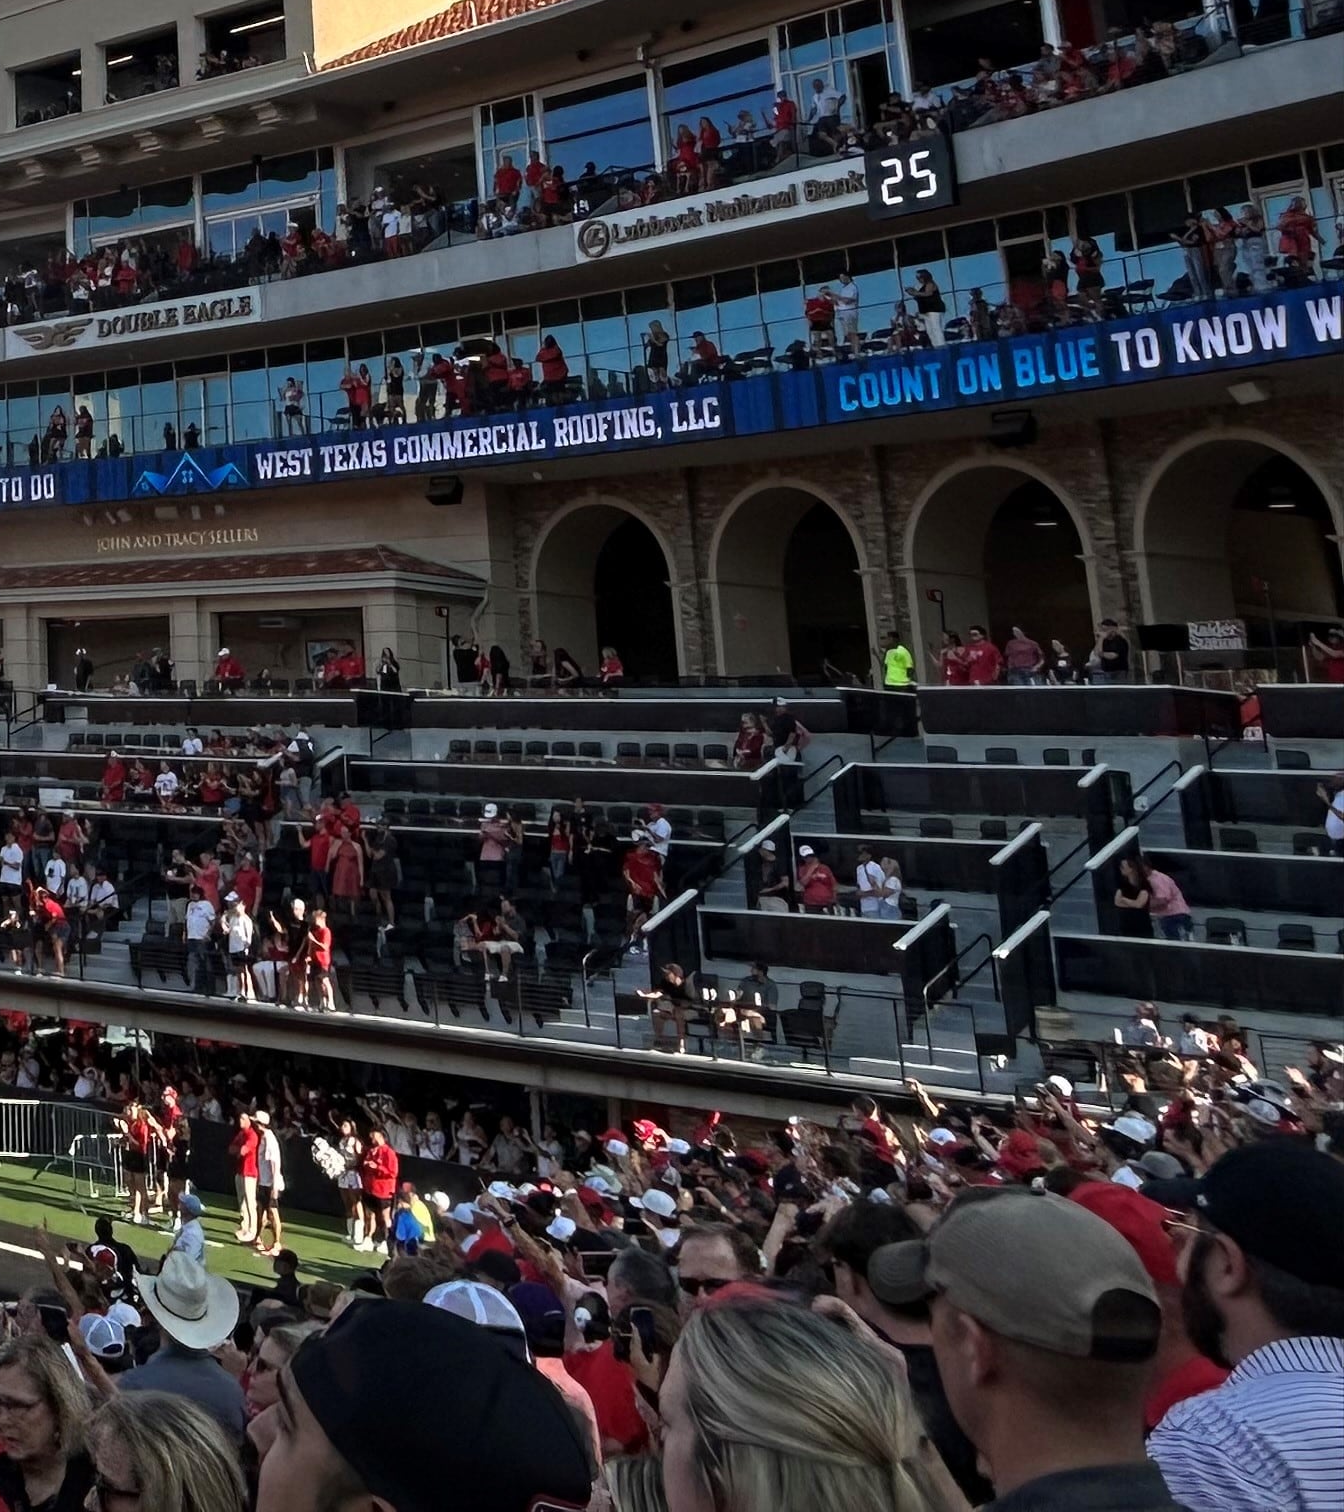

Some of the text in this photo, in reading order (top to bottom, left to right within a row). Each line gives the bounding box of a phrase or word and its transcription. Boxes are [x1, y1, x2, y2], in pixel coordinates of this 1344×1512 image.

[881, 150, 937, 206] 25
[706, 183, 797, 224] National
[97, 295, 252, 339] DOUBLE EAGLE
[839, 362, 941, 412] COUNT
[956, 353, 1002, 396] ON
[1014, 337, 1101, 387] BLUE
[1110, 326, 1161, 372] TO
[1174, 304, 1288, 364] KNOW
[255, 396, 721, 480] WEST TEXAS COMMERCIAL ROOFING, LLC
[30, 473, 55, 501] DO
[96, 535, 130, 552] JOHN
[165, 530, 206, 547] TRACY
